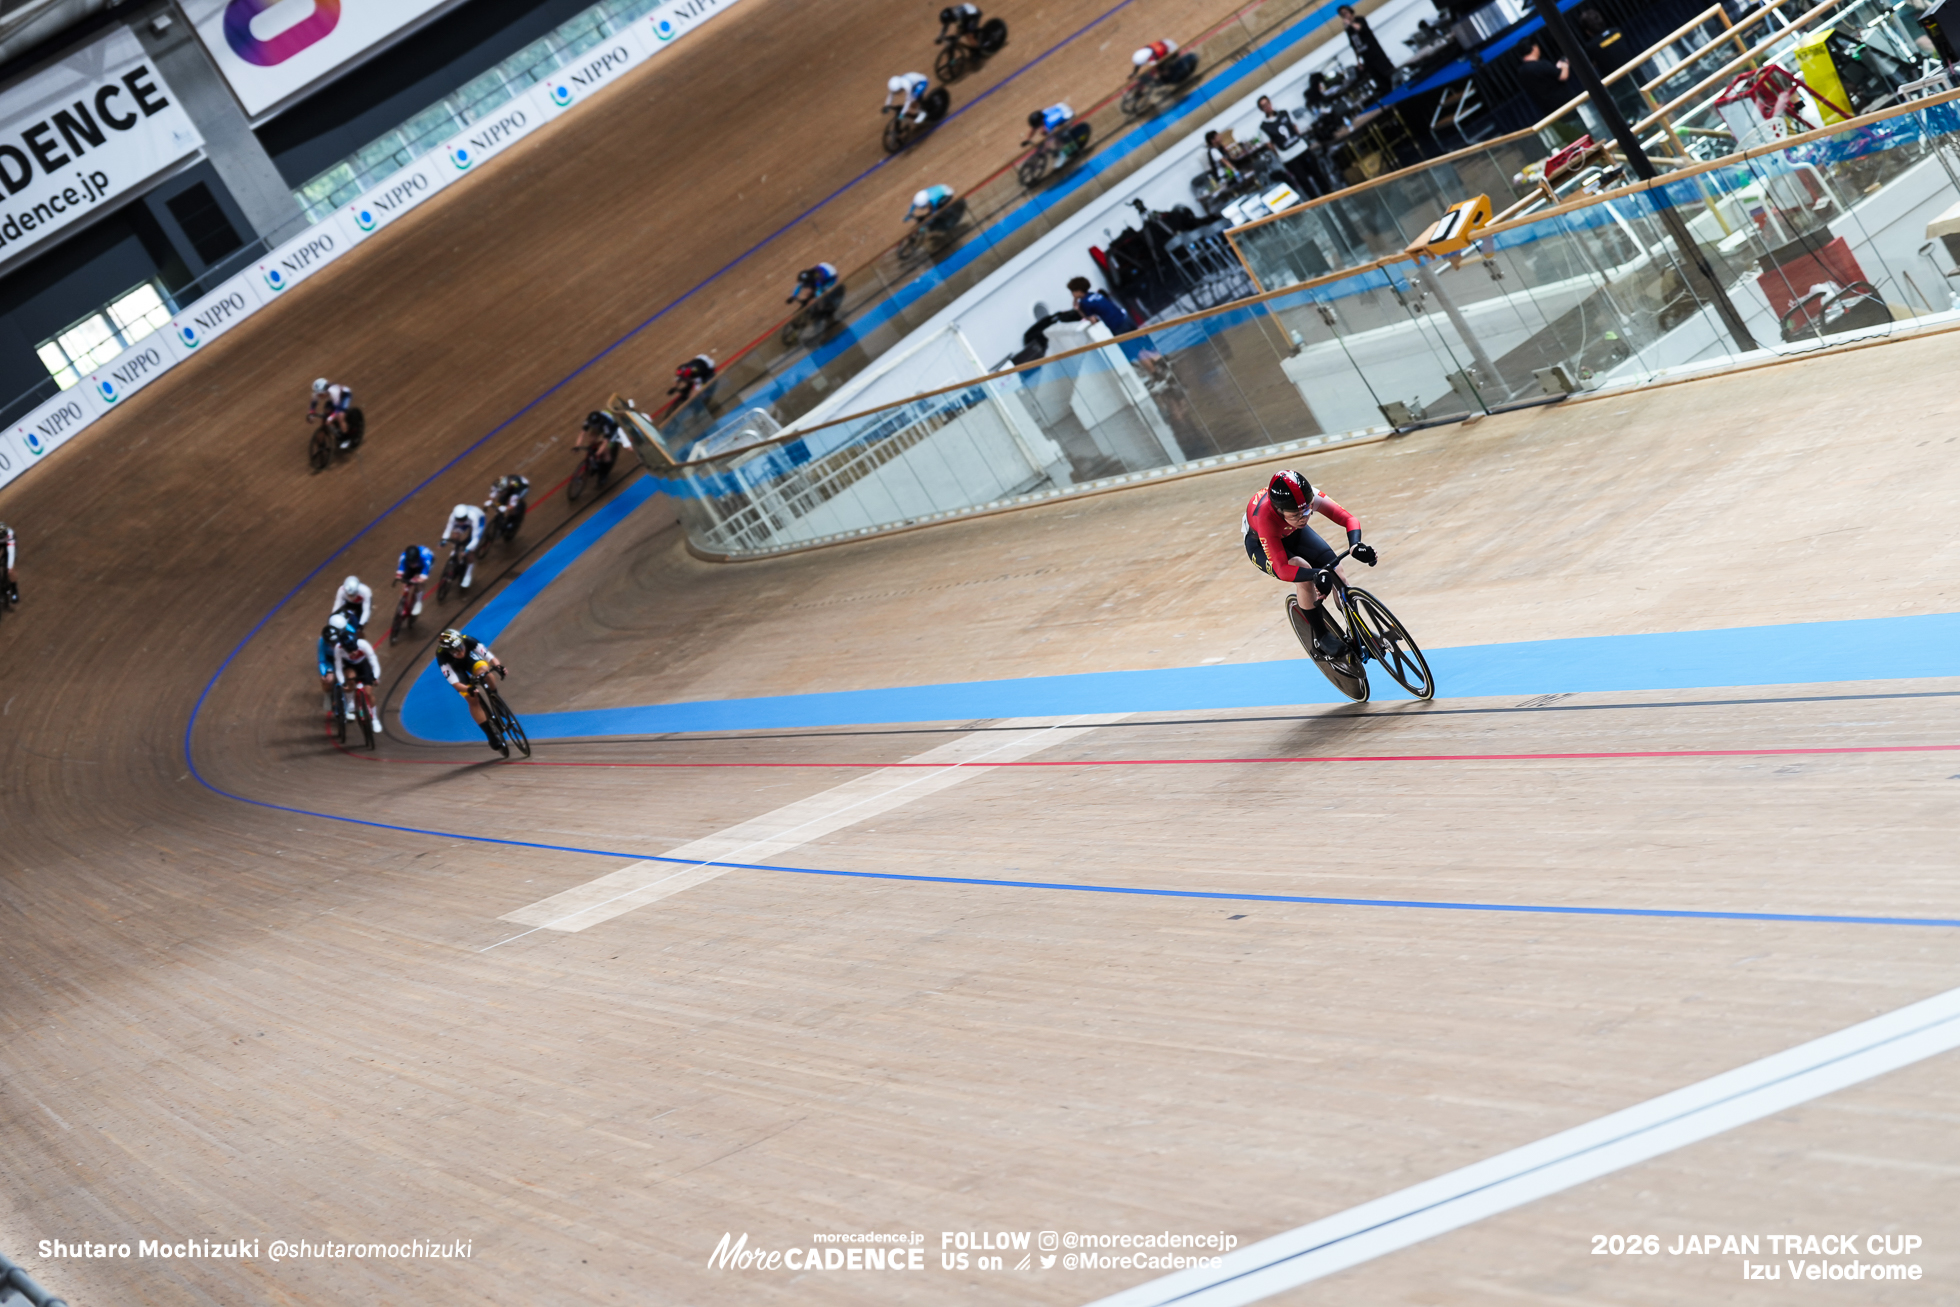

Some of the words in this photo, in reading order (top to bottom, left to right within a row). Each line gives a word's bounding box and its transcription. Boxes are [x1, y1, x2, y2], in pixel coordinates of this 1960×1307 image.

[570, 45, 630, 92] NIPPO
[0, 64, 170, 201] DENCE
[469, 109, 527, 155] NIPPO
[372, 172, 429, 217] NIPPO
[281, 233, 334, 277] NIPPO
[193, 291, 245, 335] NIPPO
[111, 347, 160, 390] NIPPO
[36, 400, 83, 442] NIPPO
